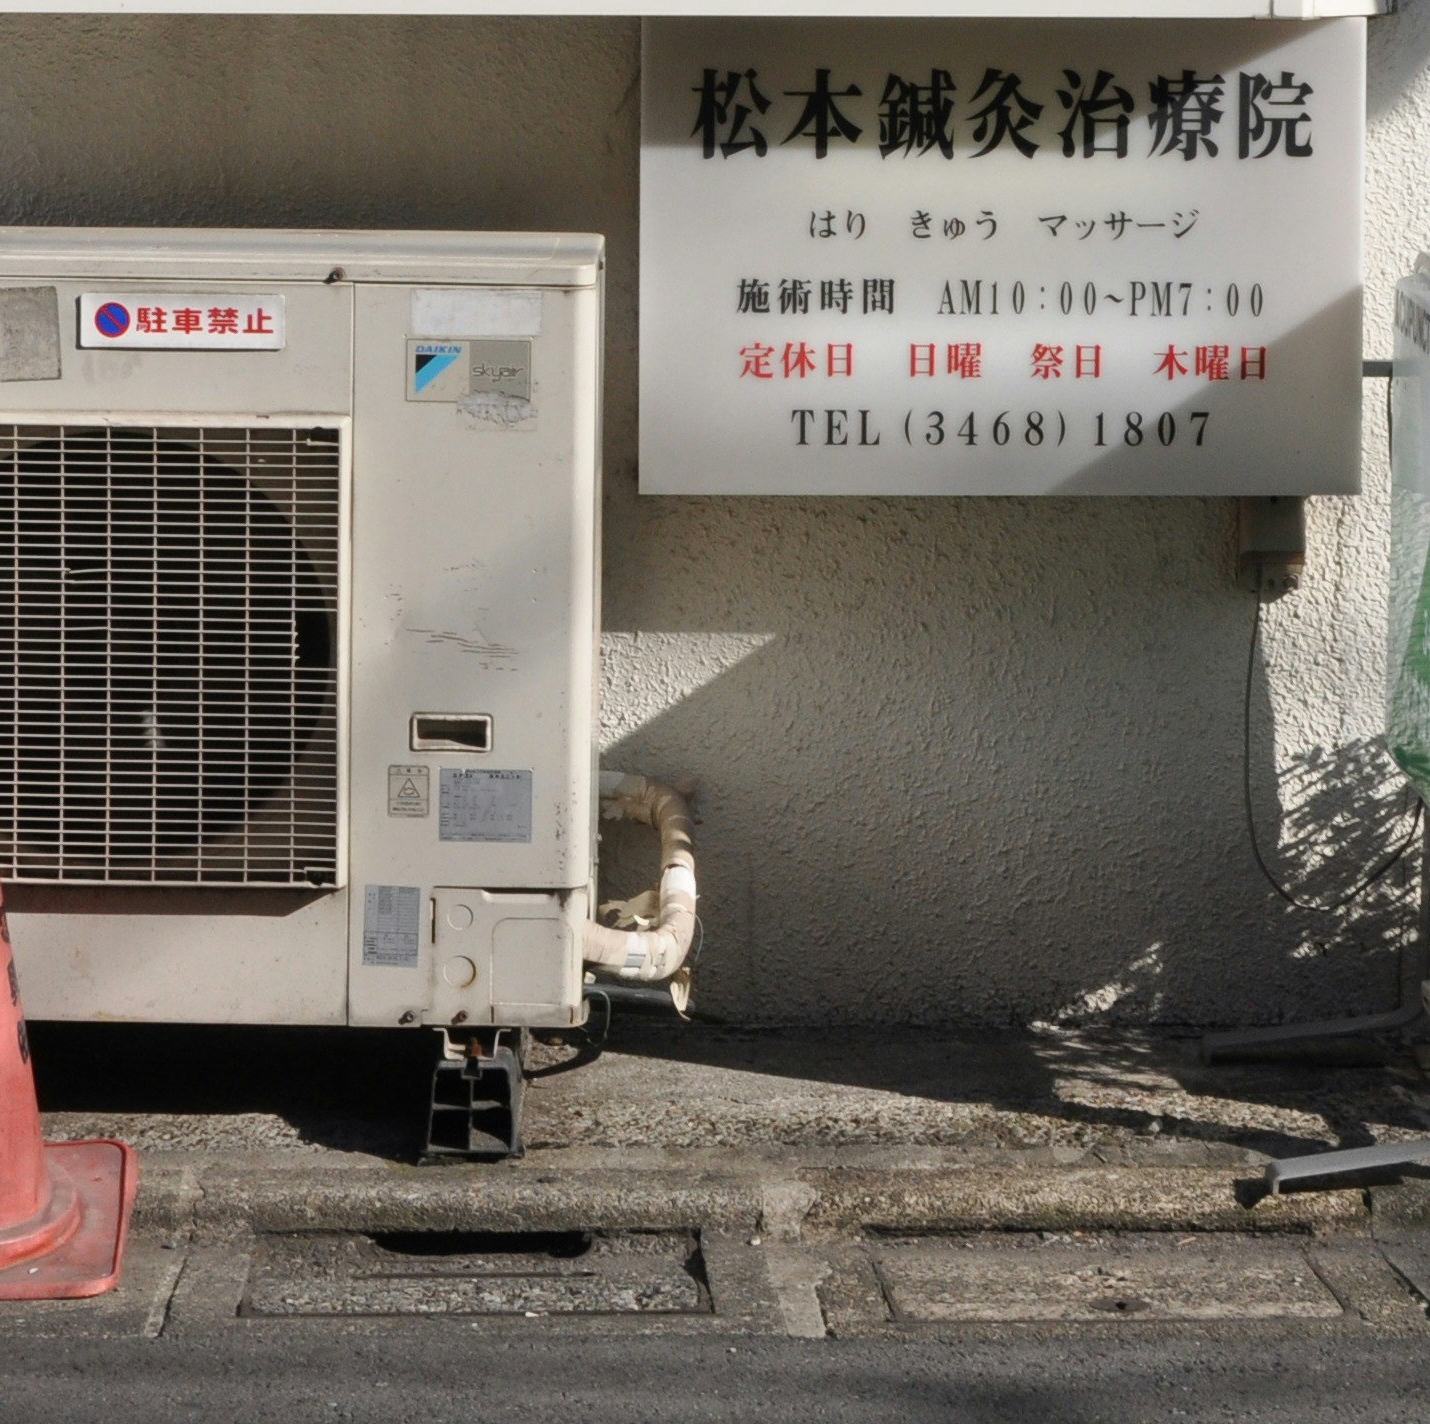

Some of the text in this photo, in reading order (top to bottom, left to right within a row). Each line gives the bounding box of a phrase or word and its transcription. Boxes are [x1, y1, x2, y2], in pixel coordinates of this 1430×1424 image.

[690, 67, 1315, 162] 松本鍼灸治療院
[808, 208, 1201, 241] はり きゅう マッサージ
[736, 278, 896, 316] 施術時間
[135, 306, 274, 336] 駐車禁止
[415, 345, 462, 354] DAIKIN
[738, 342, 1268, 382] 定休日 日曜 祭日 木曜日
